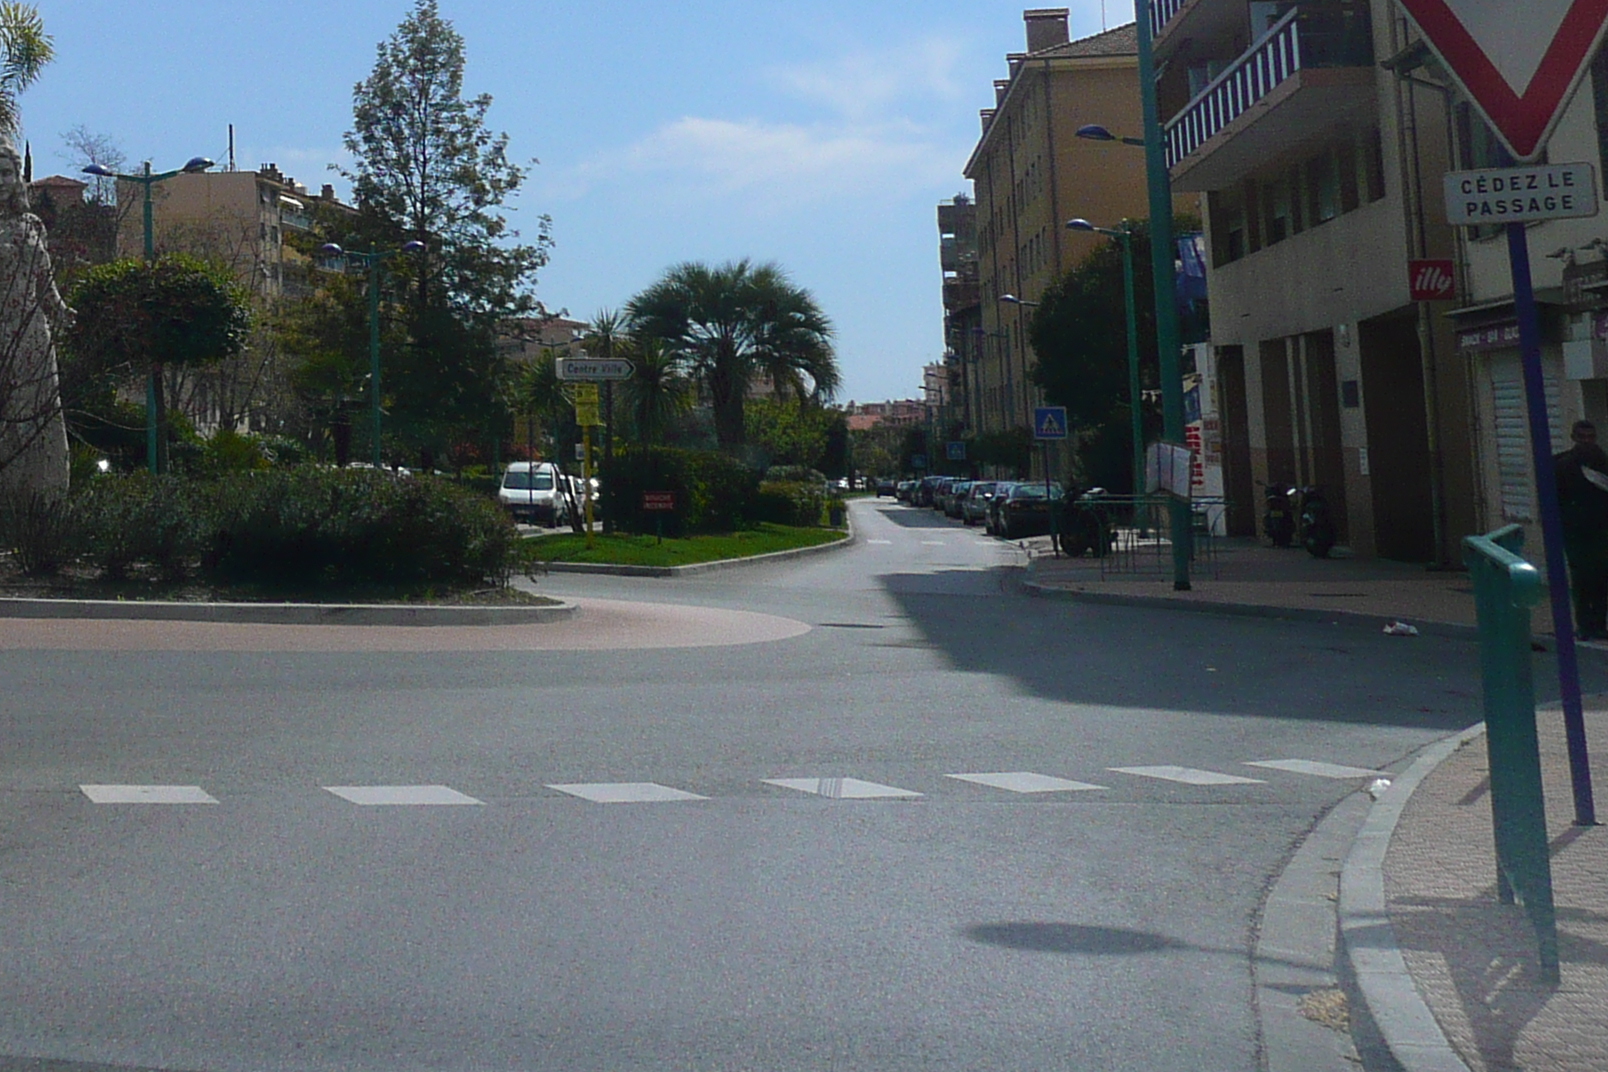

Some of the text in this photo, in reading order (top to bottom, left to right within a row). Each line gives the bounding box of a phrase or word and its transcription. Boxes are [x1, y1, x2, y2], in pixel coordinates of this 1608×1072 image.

[1461, 171, 1574, 195] CÉDEZ LE
[1466, 195, 1573, 216] PASSAGE
[1415, 266, 1452, 296] illy
[567, 362, 623, 374] Centre Ville
